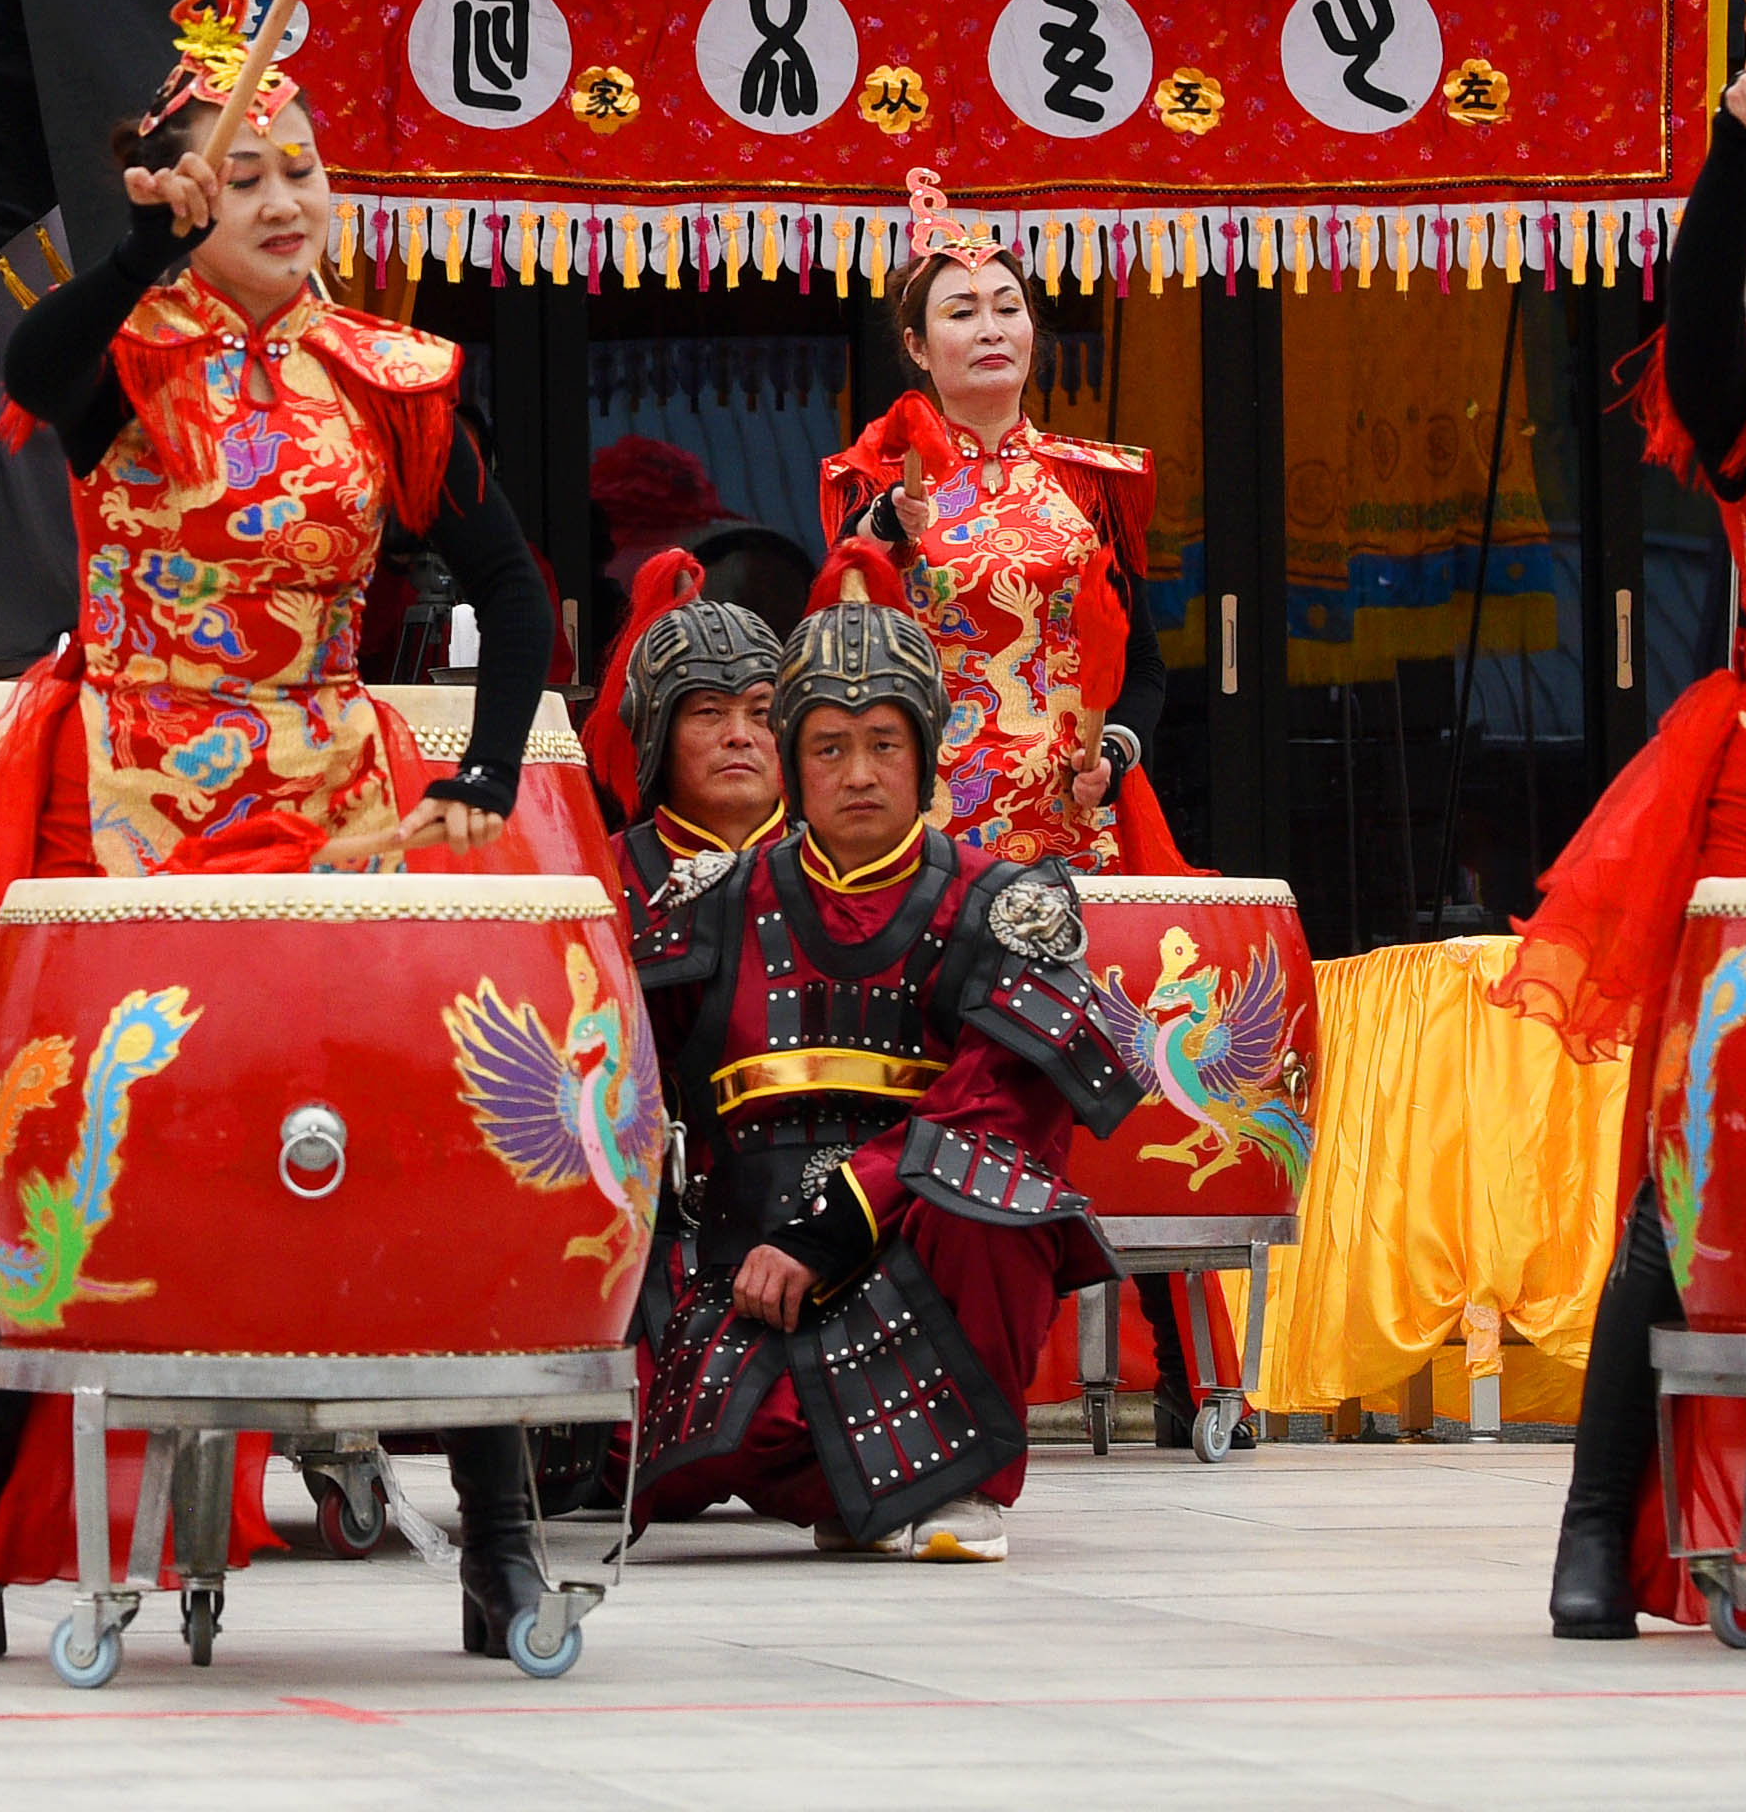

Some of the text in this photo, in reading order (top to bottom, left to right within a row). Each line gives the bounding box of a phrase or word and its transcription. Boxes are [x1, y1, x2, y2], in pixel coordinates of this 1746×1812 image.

[584, 76, 630, 119] 家
[870, 79, 922, 115] 从
[1173, 80, 1212, 116] 互
[1454, 71, 1498, 110] 左
